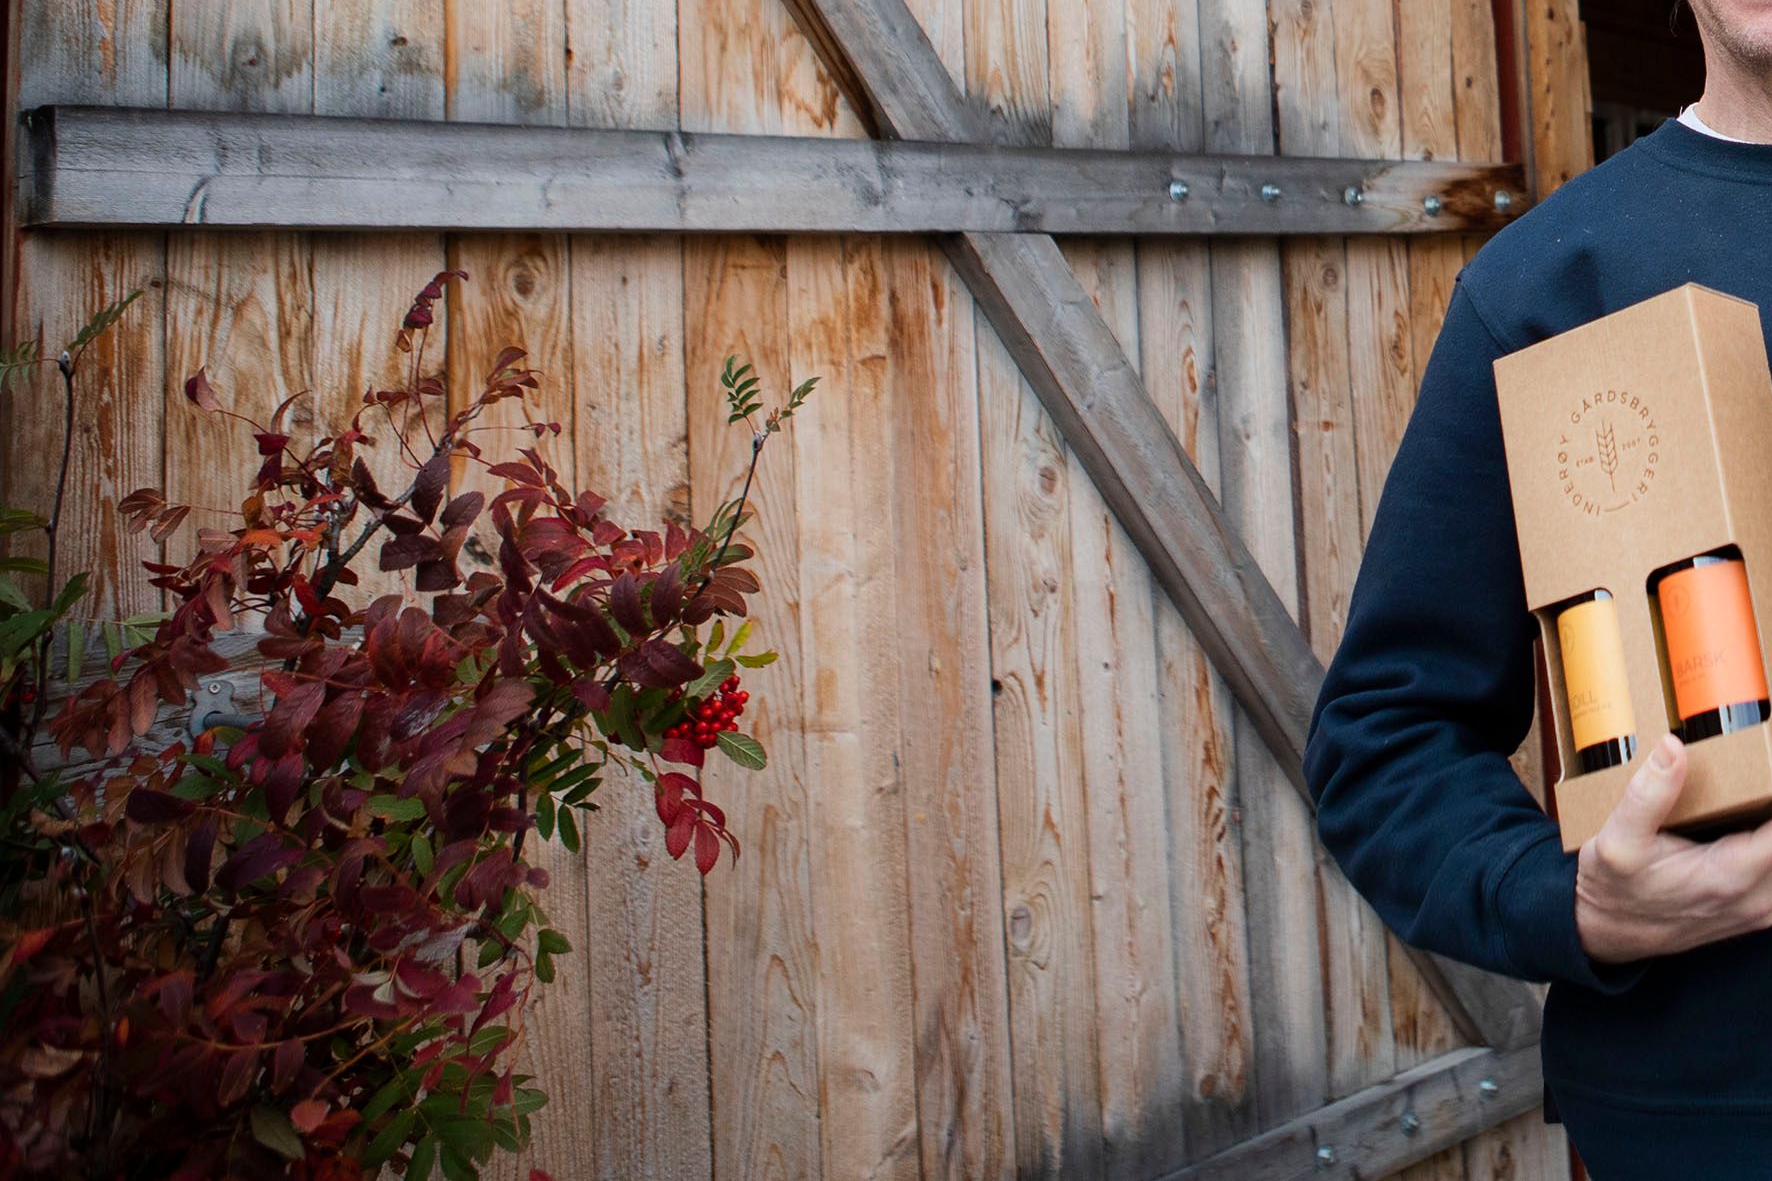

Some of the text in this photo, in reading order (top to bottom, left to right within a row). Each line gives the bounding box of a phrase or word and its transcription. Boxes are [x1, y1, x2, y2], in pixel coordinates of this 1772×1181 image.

[1557, 388, 1659, 516] INDERØY GÅRDSBRYGGERI
[1677, 650, 1728, 679] BARSK
